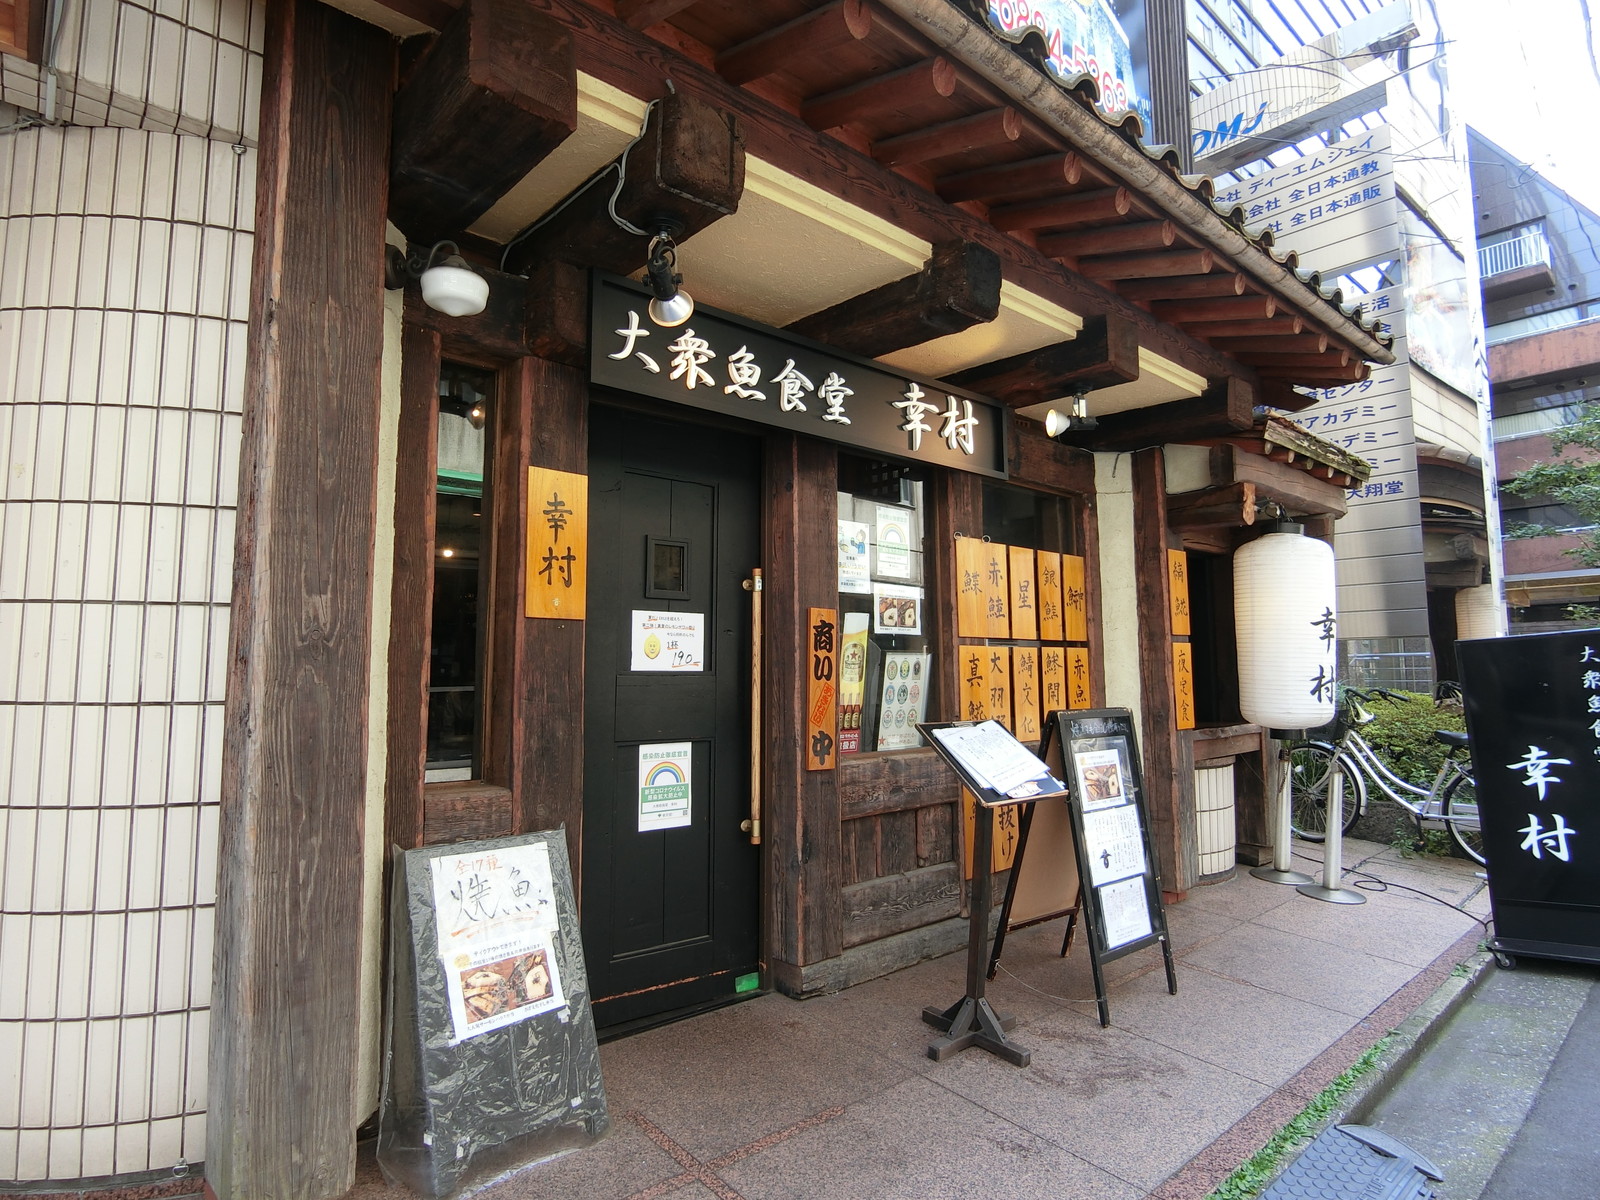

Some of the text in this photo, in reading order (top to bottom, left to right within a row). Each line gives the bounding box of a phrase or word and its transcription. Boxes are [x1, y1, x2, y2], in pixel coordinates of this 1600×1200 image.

[1192, 102, 1268, 156] DMJ
[1248, 135, 1374, 195] ディーエムジェイ
[1244, 160, 1380, 220] 会社 全日本通教
[1290, 184, 1381, 227] 全日本通販
[607, 310, 980, 455] 大衆魚食堂 幸村
[538, 492, 577, 588] 幸村
[812, 619, 835, 766] 商い中
[1310, 606, 1336, 704] 幸村
[1506, 745, 1577, 862] 幸村
